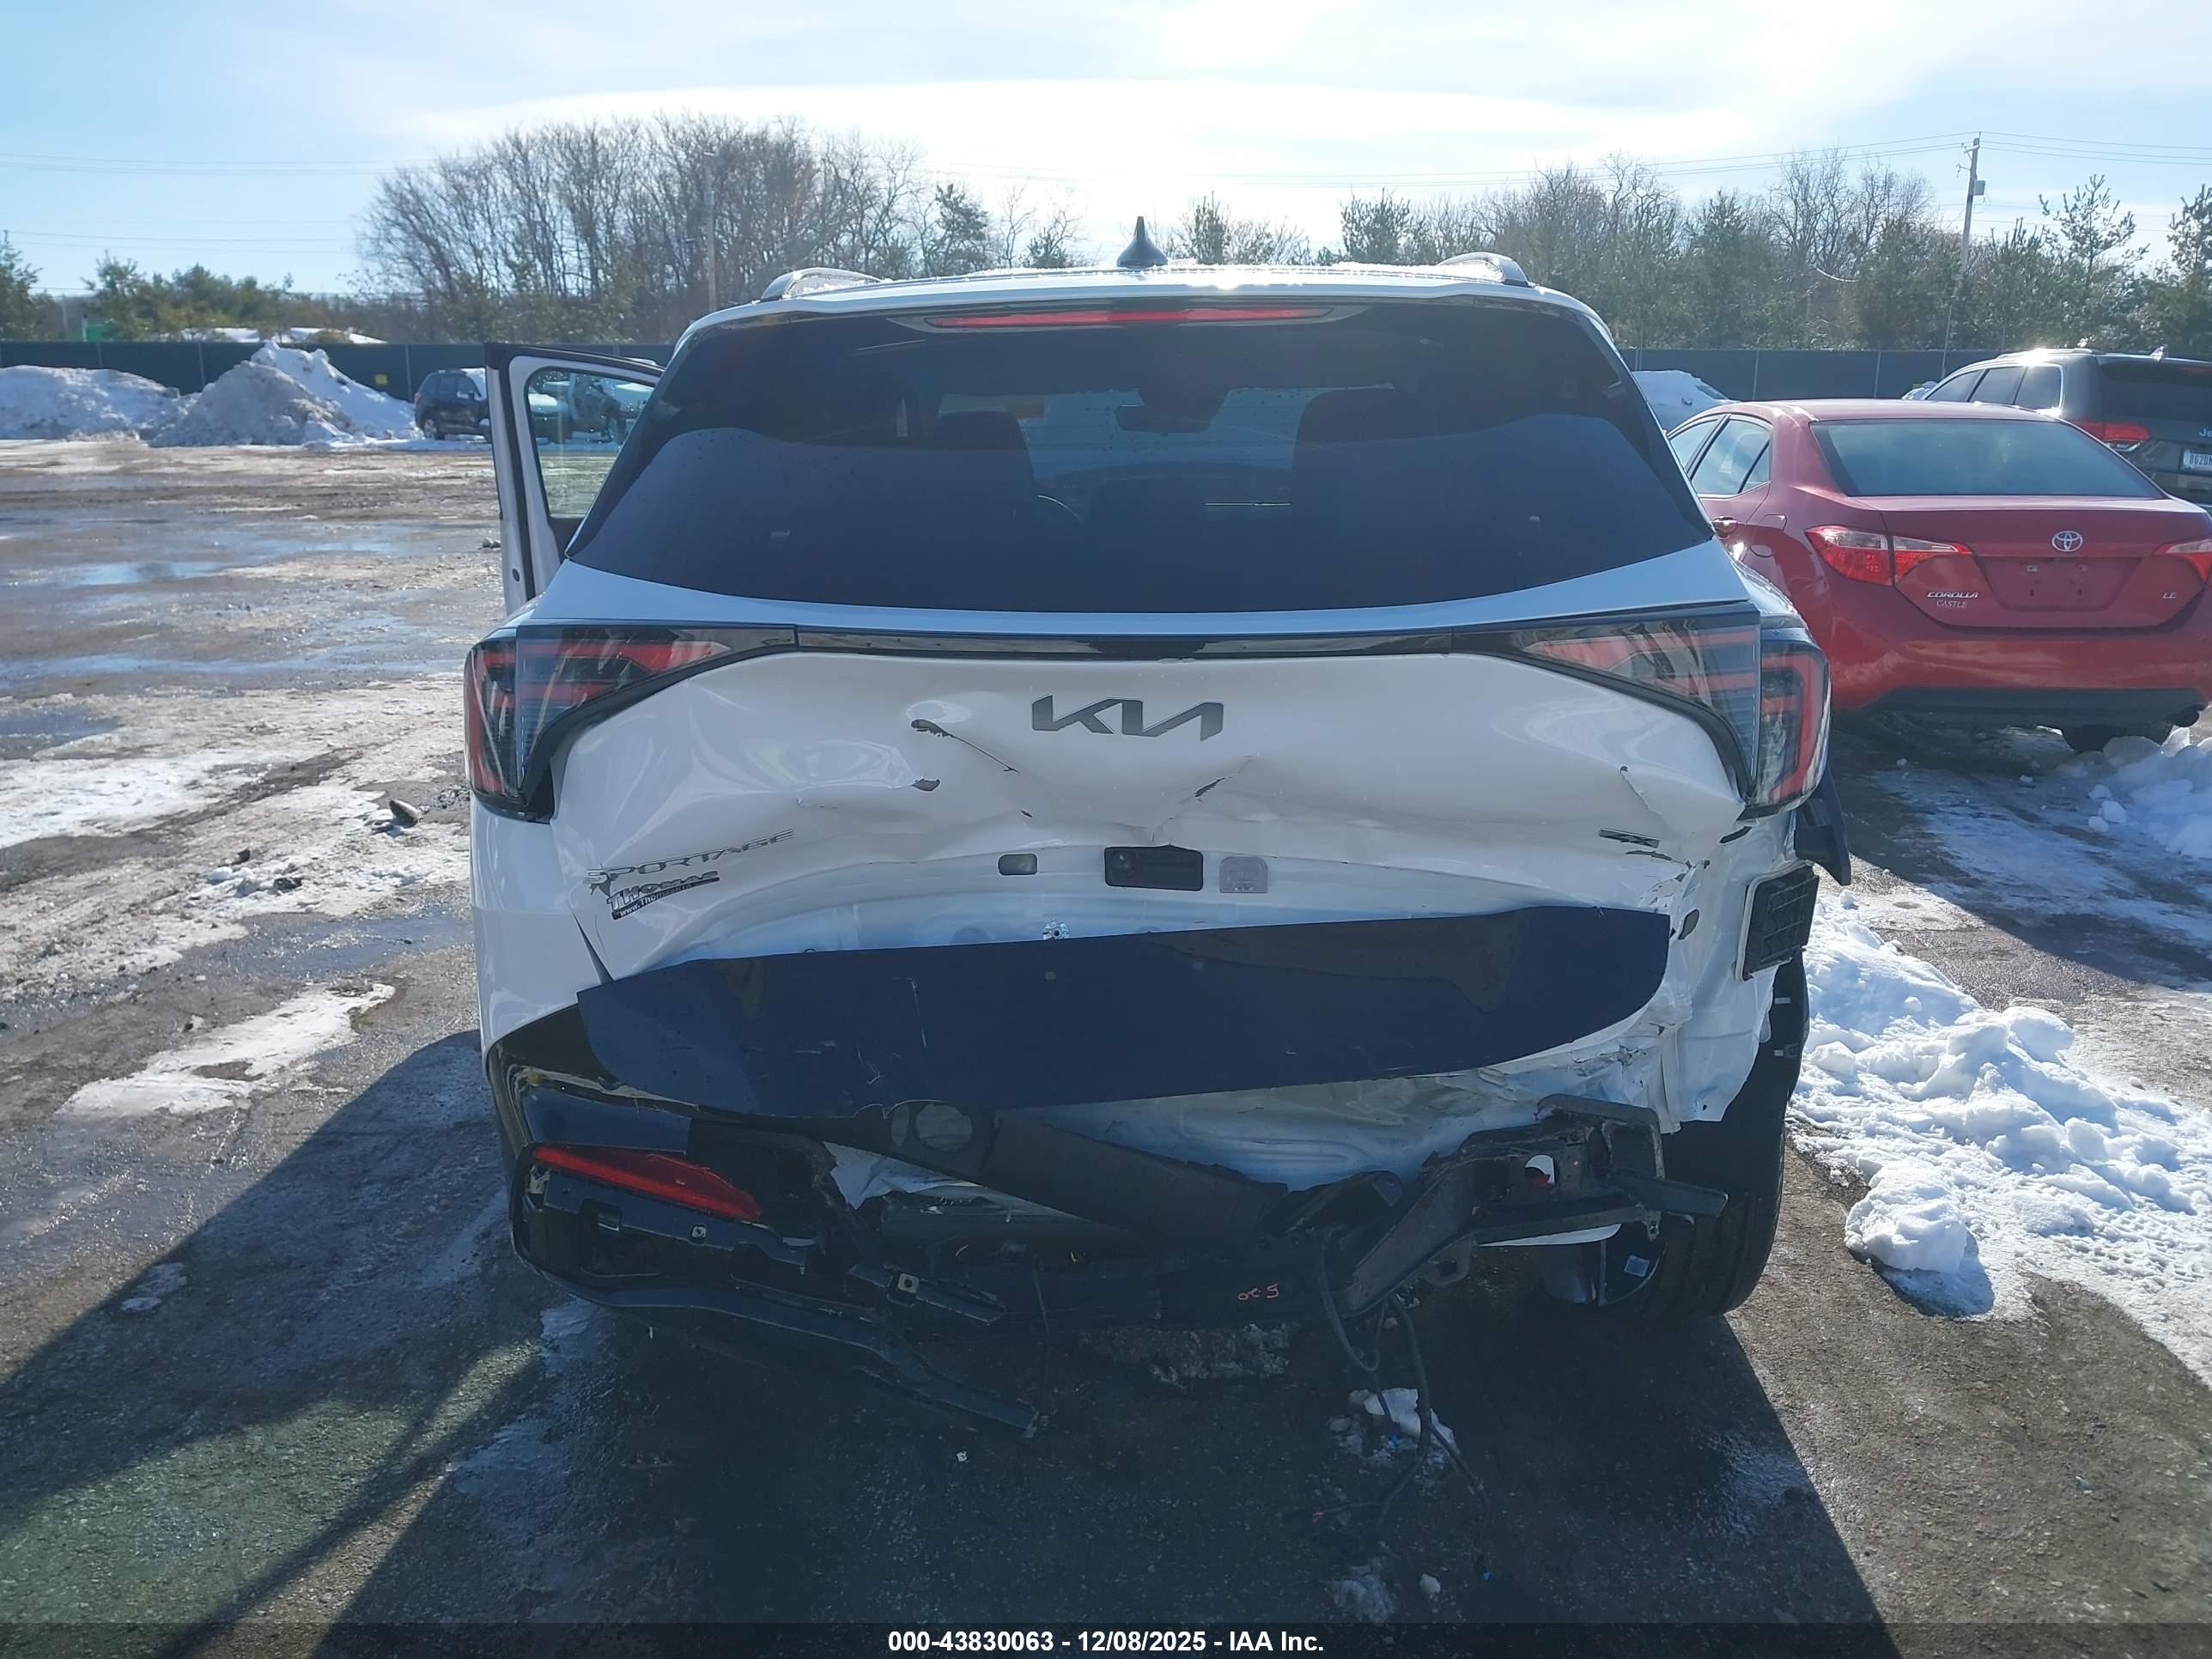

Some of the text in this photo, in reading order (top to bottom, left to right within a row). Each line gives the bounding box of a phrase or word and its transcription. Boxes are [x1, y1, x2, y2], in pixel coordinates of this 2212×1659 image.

[1936, 599, 1966, 609] CASTLE
[1031, 693, 1224, 742] KIA
[582, 828, 794, 884] SPORTAGE
[605, 870, 720, 911] THOMAS
